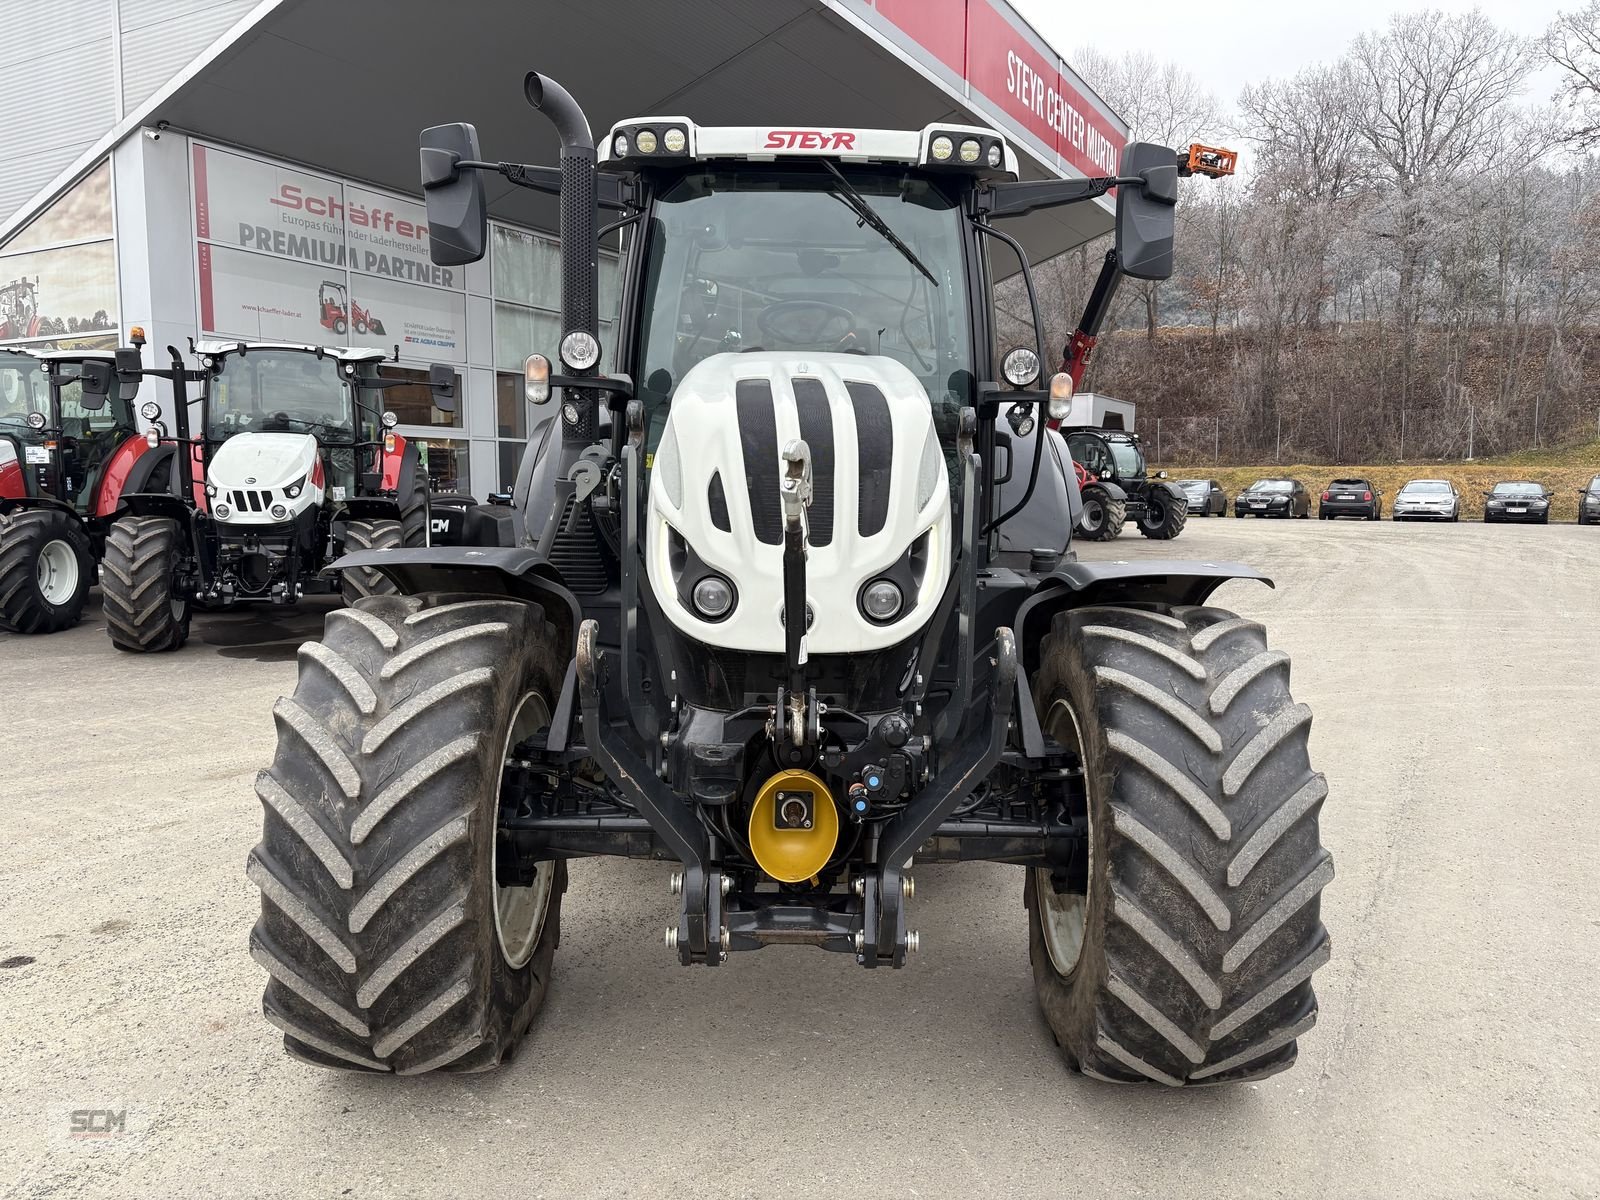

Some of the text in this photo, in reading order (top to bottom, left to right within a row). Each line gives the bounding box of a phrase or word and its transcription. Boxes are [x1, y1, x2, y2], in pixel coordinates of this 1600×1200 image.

[1007, 49, 1045, 119] STEYR
[1047, 87, 1085, 154] CENTER
[763, 131, 856, 150] STEYR
[270, 184, 430, 240] Schäffer
[282, 212, 321, 231] Europas
[369, 235, 429, 256] Laderhersteller
[239, 222, 453, 288] PREMIUM PARTNER
